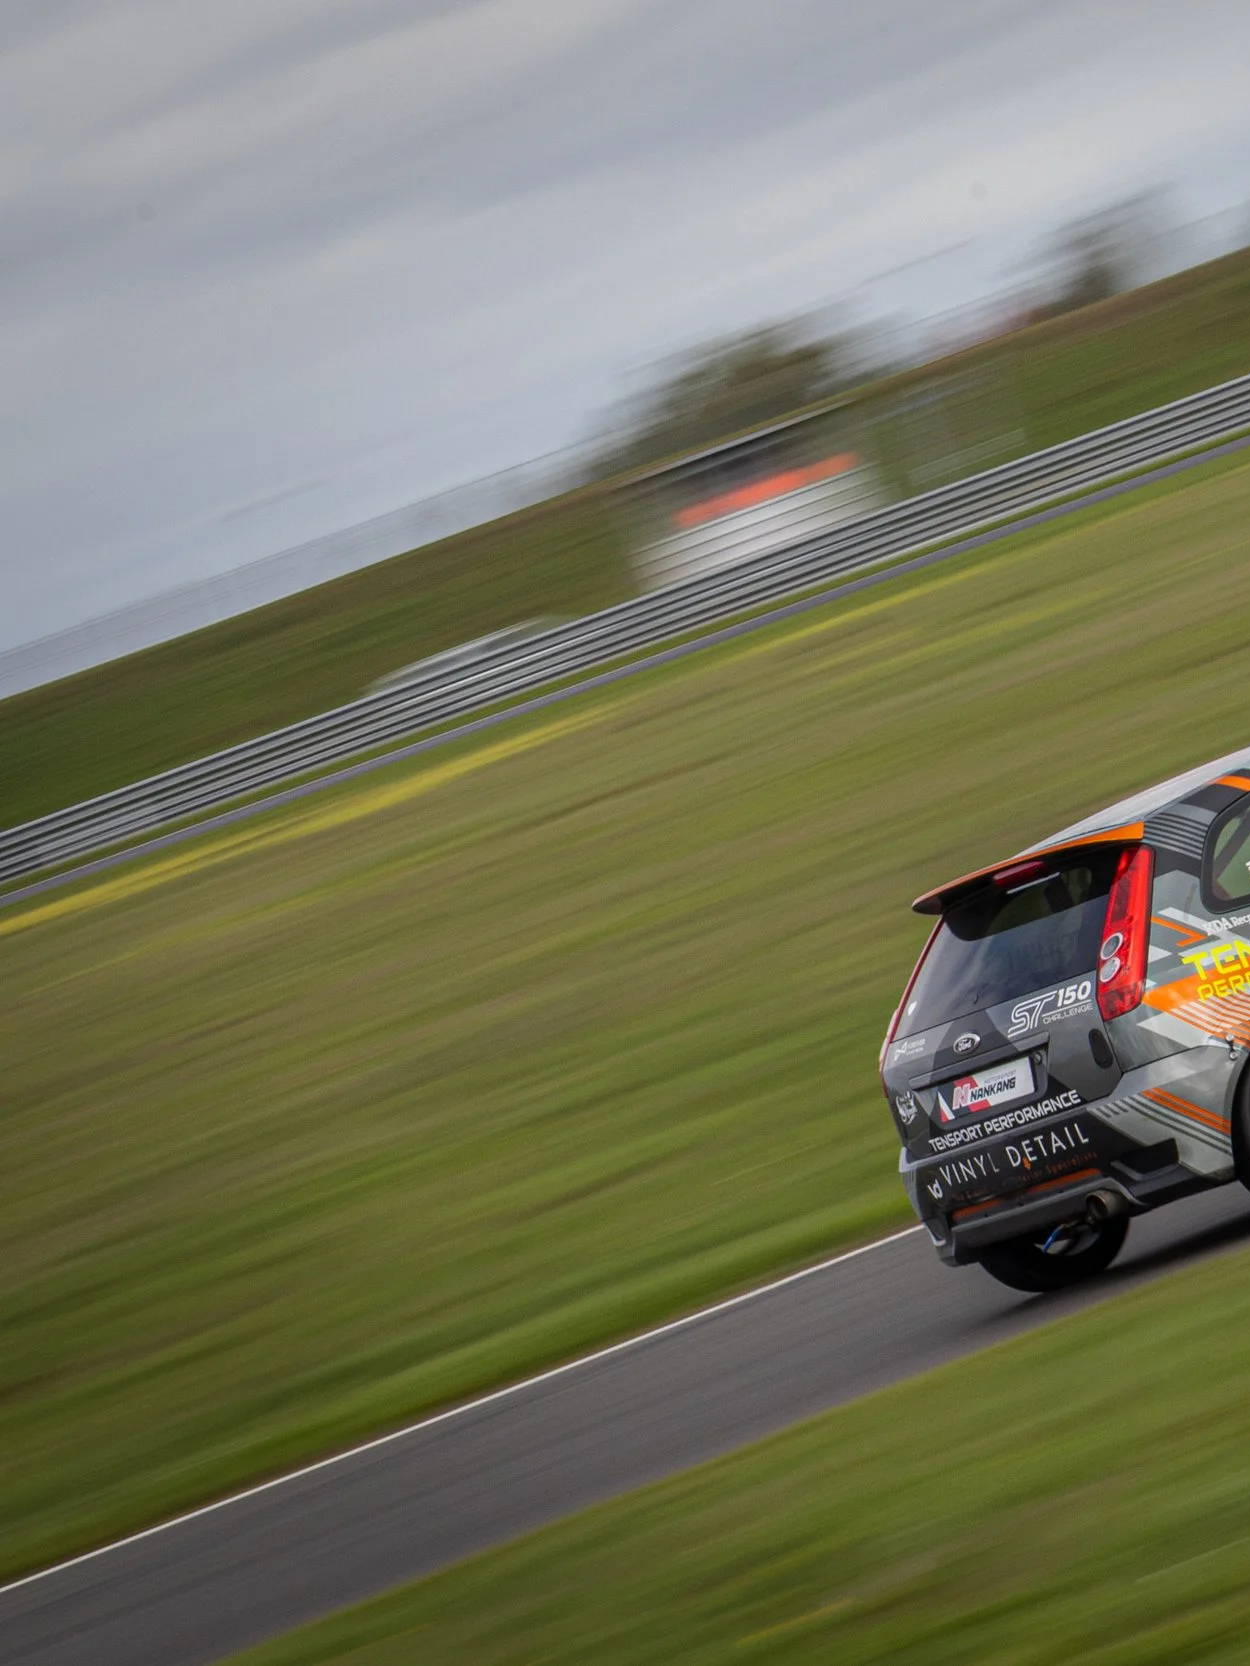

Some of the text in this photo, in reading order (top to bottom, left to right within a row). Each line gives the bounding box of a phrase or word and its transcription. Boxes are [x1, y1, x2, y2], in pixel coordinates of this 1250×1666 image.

[1203, 917, 1232, 936] KDA
[1008, 981, 1092, 1038] ST 150
[1042, 1003, 1093, 1025] CHALLENGE
[970, 1077, 1016, 1102] NANKANG
[928, 1090, 1081, 1152] TENSPORT PERFORMANCE
[939, 1153, 999, 1187] VINYL
[1005, 1123, 1090, 1168] DETAIL
